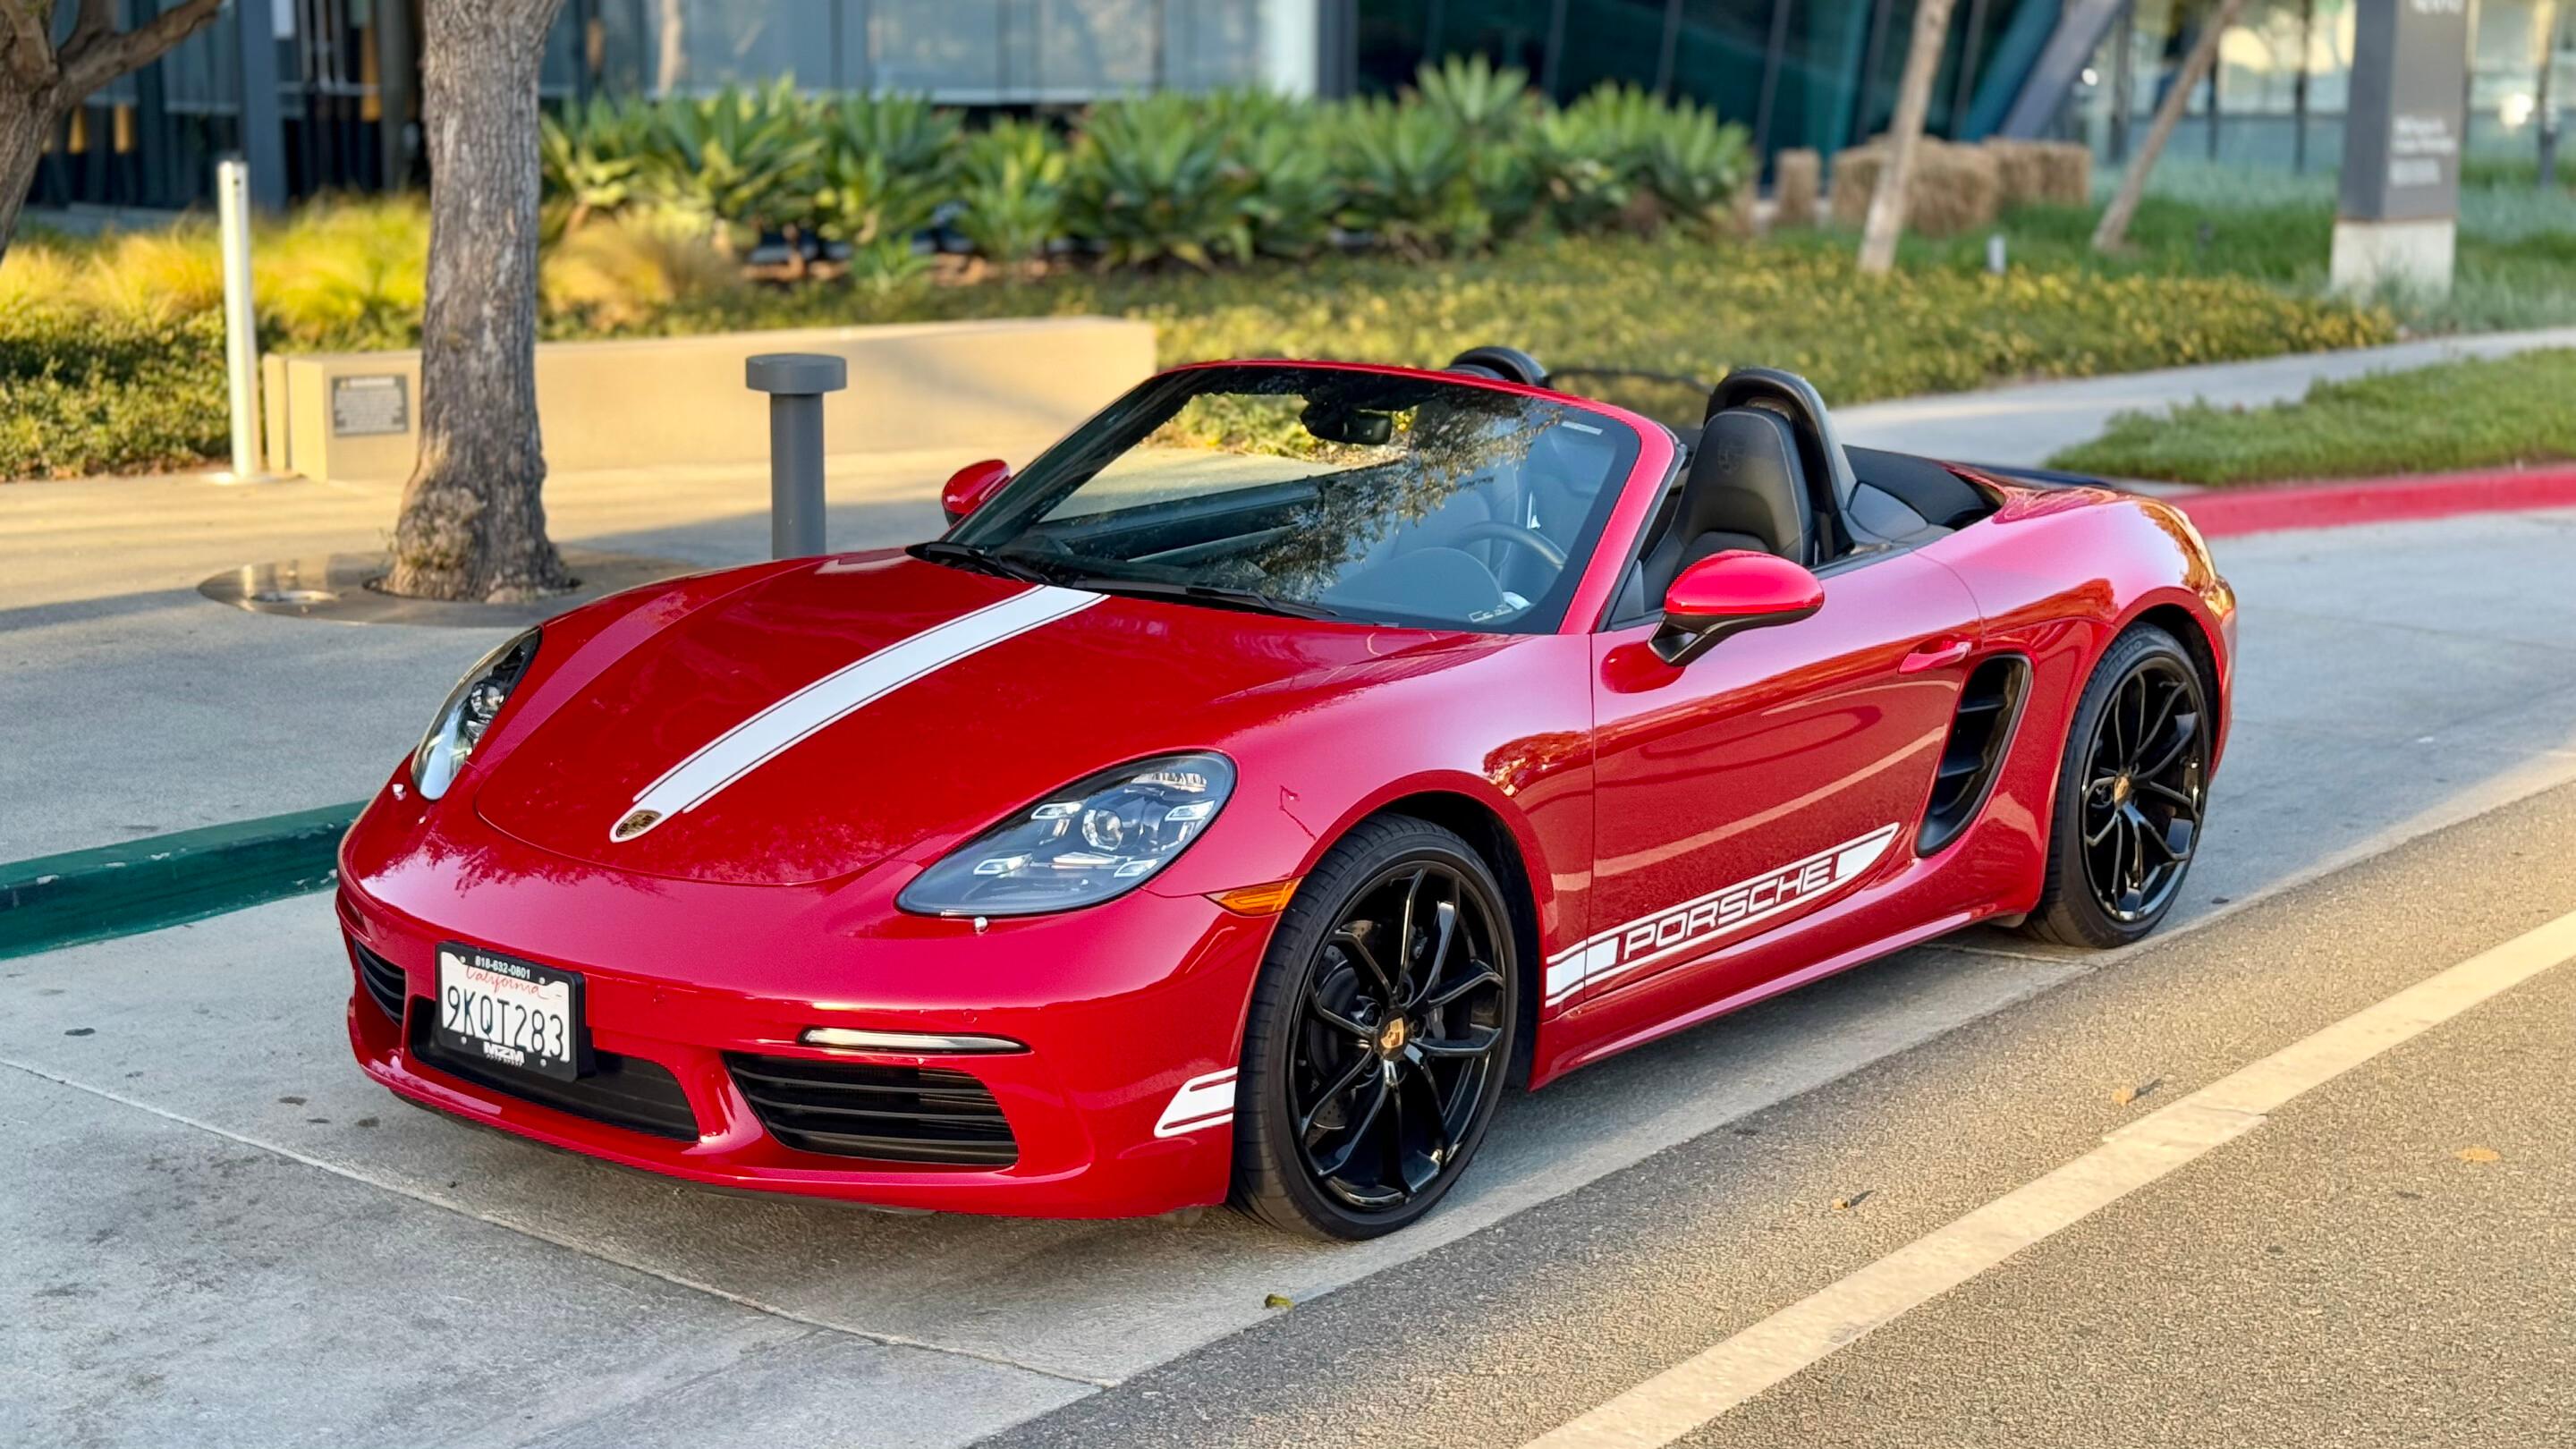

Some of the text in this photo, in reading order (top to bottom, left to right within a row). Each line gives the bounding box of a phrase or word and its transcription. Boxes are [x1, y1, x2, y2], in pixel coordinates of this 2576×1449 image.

[1623, 856, 1833, 960] PORSCHE
[466, 965, 549, 999] California
[447, 986, 564, 1056] 9KQT283
